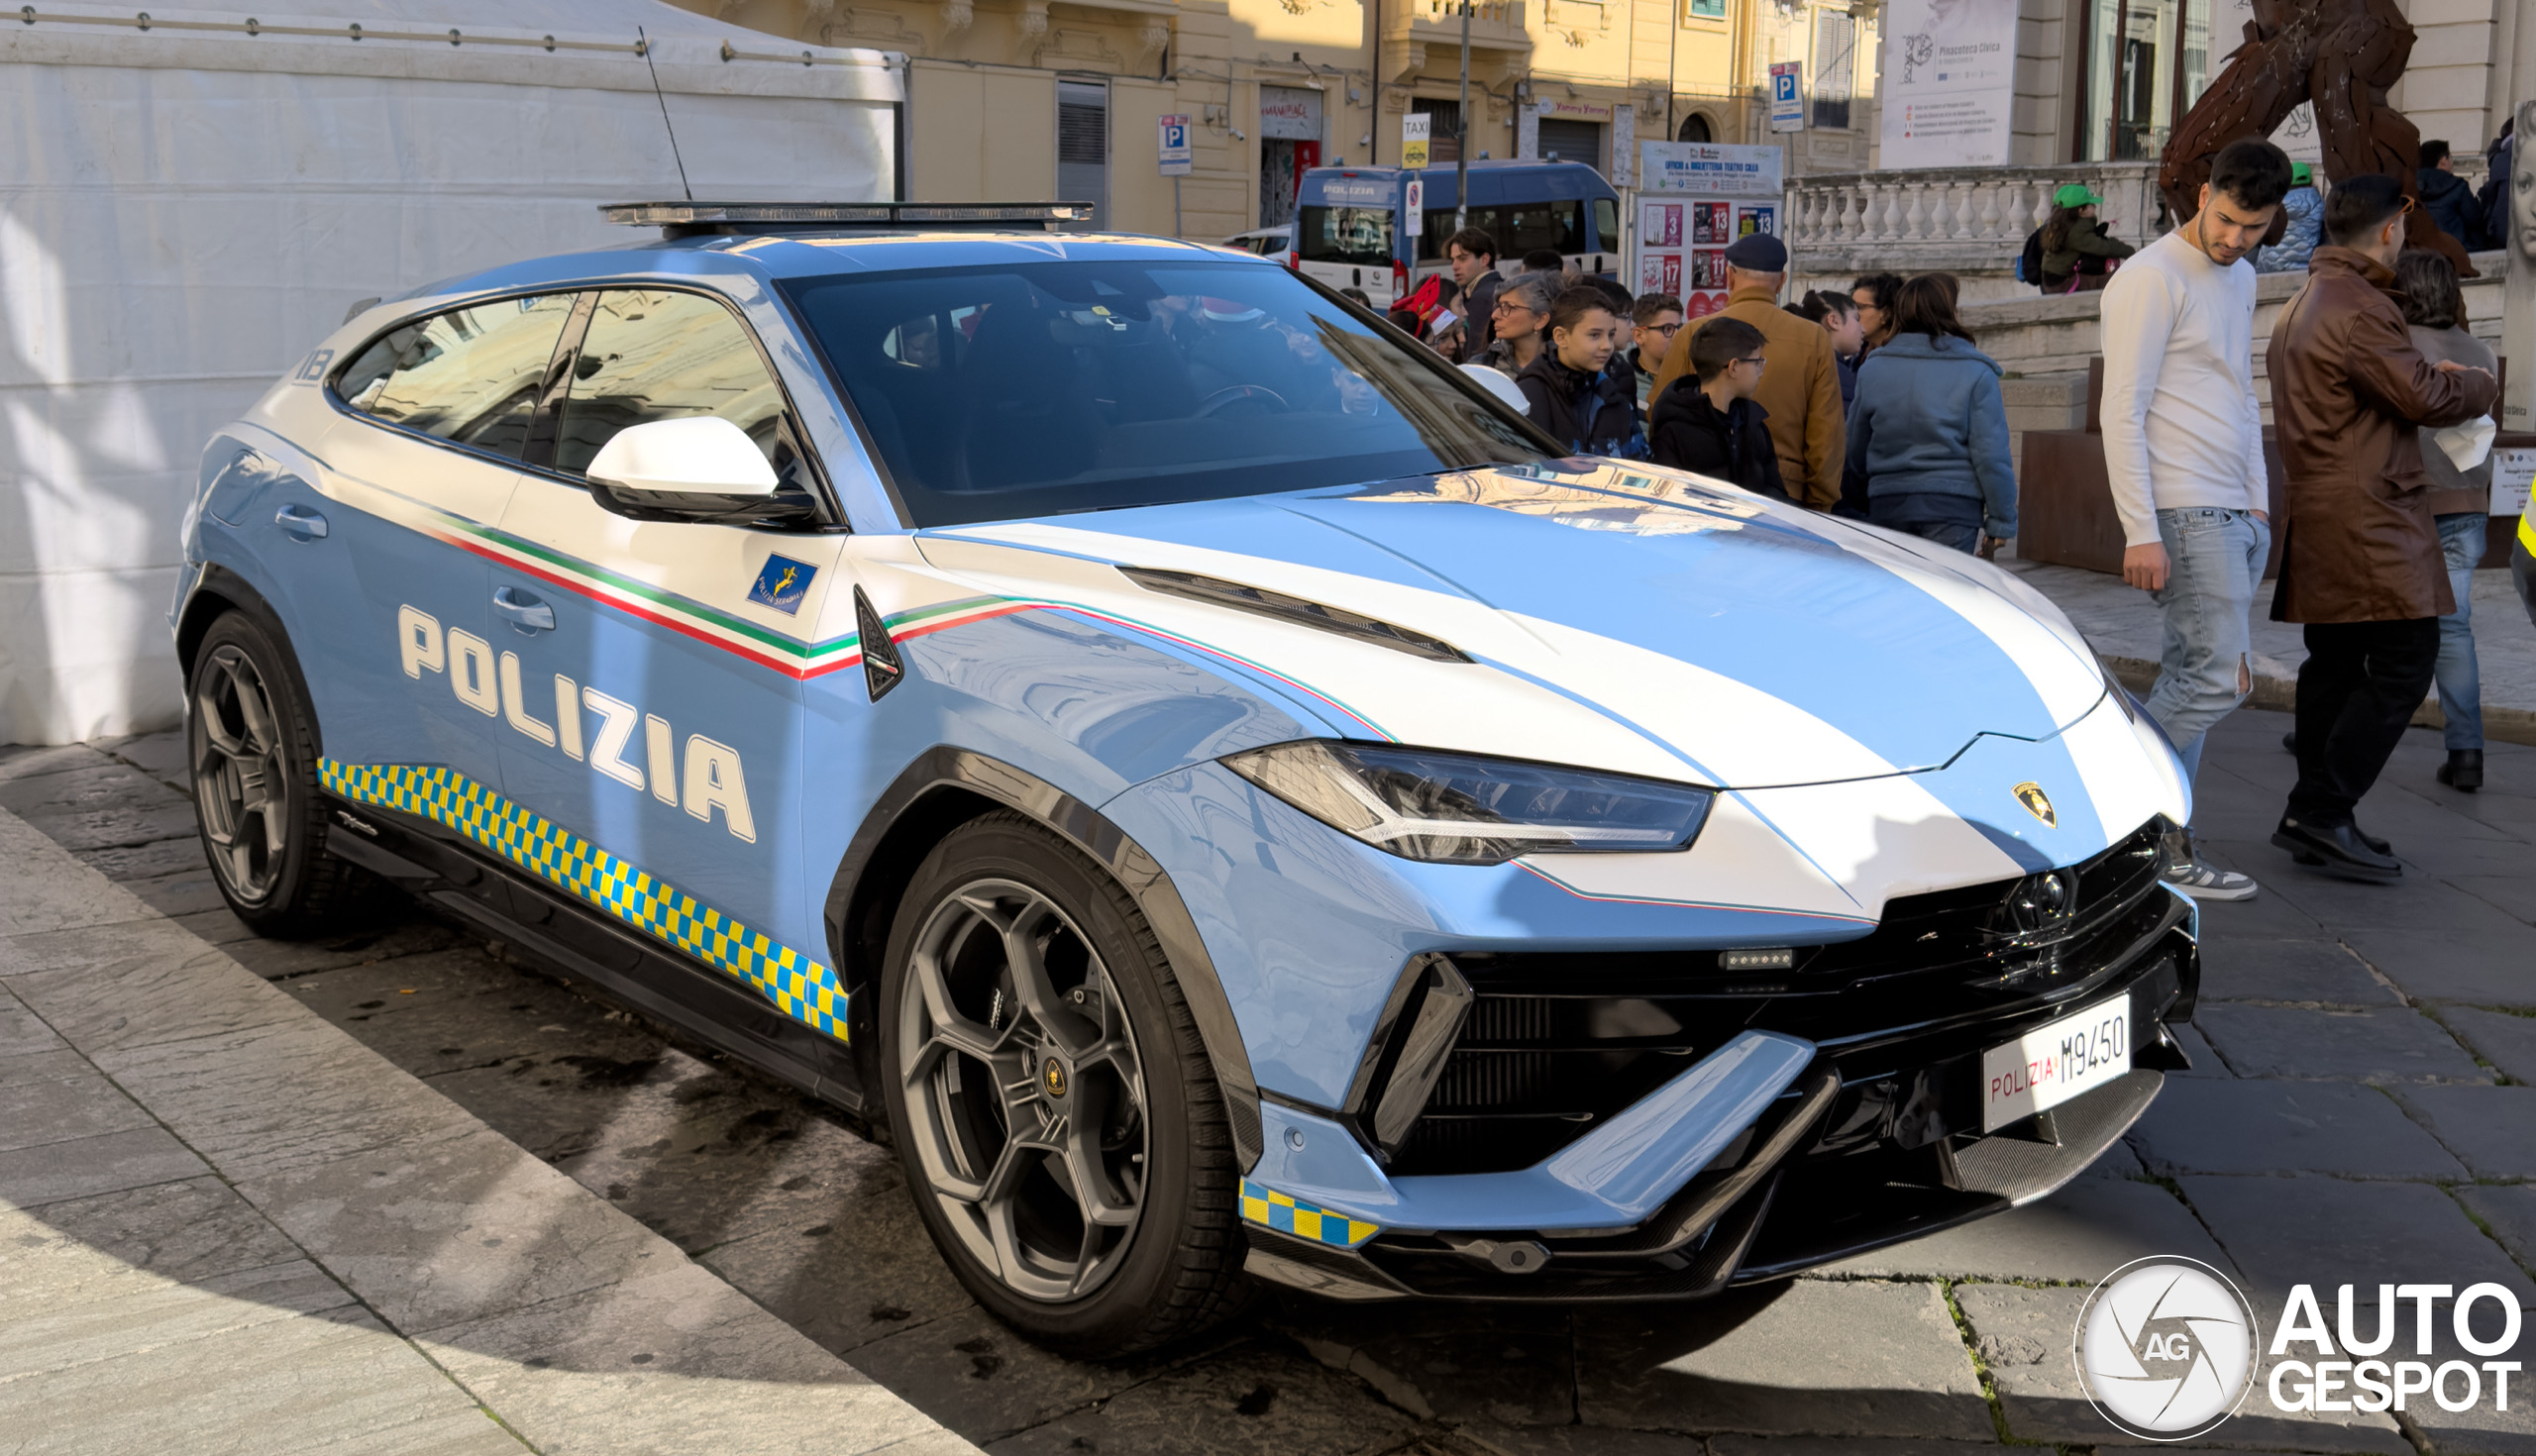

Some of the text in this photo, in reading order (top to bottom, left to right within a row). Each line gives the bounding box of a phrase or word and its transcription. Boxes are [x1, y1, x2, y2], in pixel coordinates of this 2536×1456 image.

[1779, 76, 1792, 99] P
[1169, 127, 1181, 146] P
[1405, 121, 1428, 134] TAXI
[1322, 185, 1374, 195] POLIZIA
[1669, 217, 1677, 235] 3
[1714, 211, 1728, 230] 13
[1758, 216, 1771, 235] 13
[1664, 263, 1679, 282] 17
[1713, 258, 1726, 275] 11
[398, 603, 756, 844] POLIZIA
[1991, 1015, 2124, 1103] POLIZIA M9450
